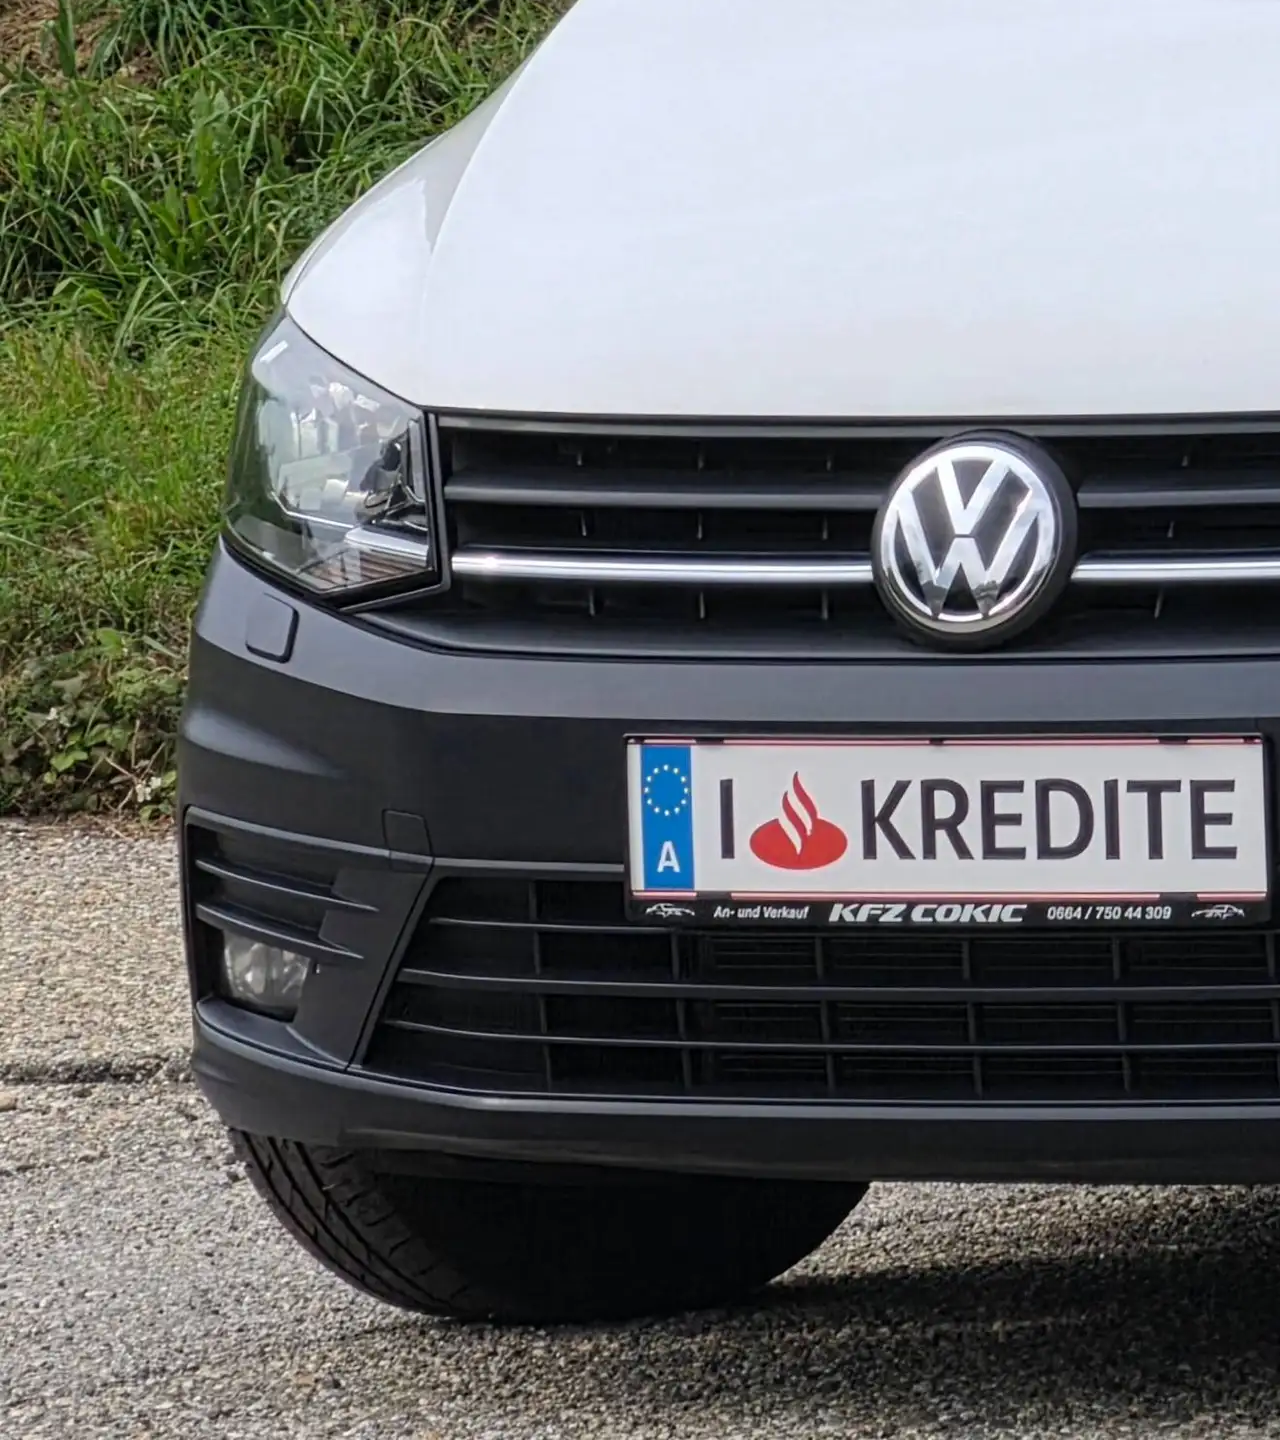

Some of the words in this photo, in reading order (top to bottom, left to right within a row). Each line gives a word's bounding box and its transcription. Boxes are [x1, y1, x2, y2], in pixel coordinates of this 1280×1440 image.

[884, 449, 1052, 627] VW
[719, 778, 735, 860] I
[861, 777, 1238, 860] KREDITE
[656, 840, 681, 873] A
[713, 905, 735, 918] An-
[737, 905, 760, 918] und
[763, 905, 809, 919] Verkauf
[828, 903, 907, 922] KFZ
[910, 903, 1028, 922] COKIC
[1084, 906, 1093, 920] /
[1095, 906, 1122, 920] 750
[1124, 906, 1142, 920] 44
[1144, 906, 1172, 920] 309
